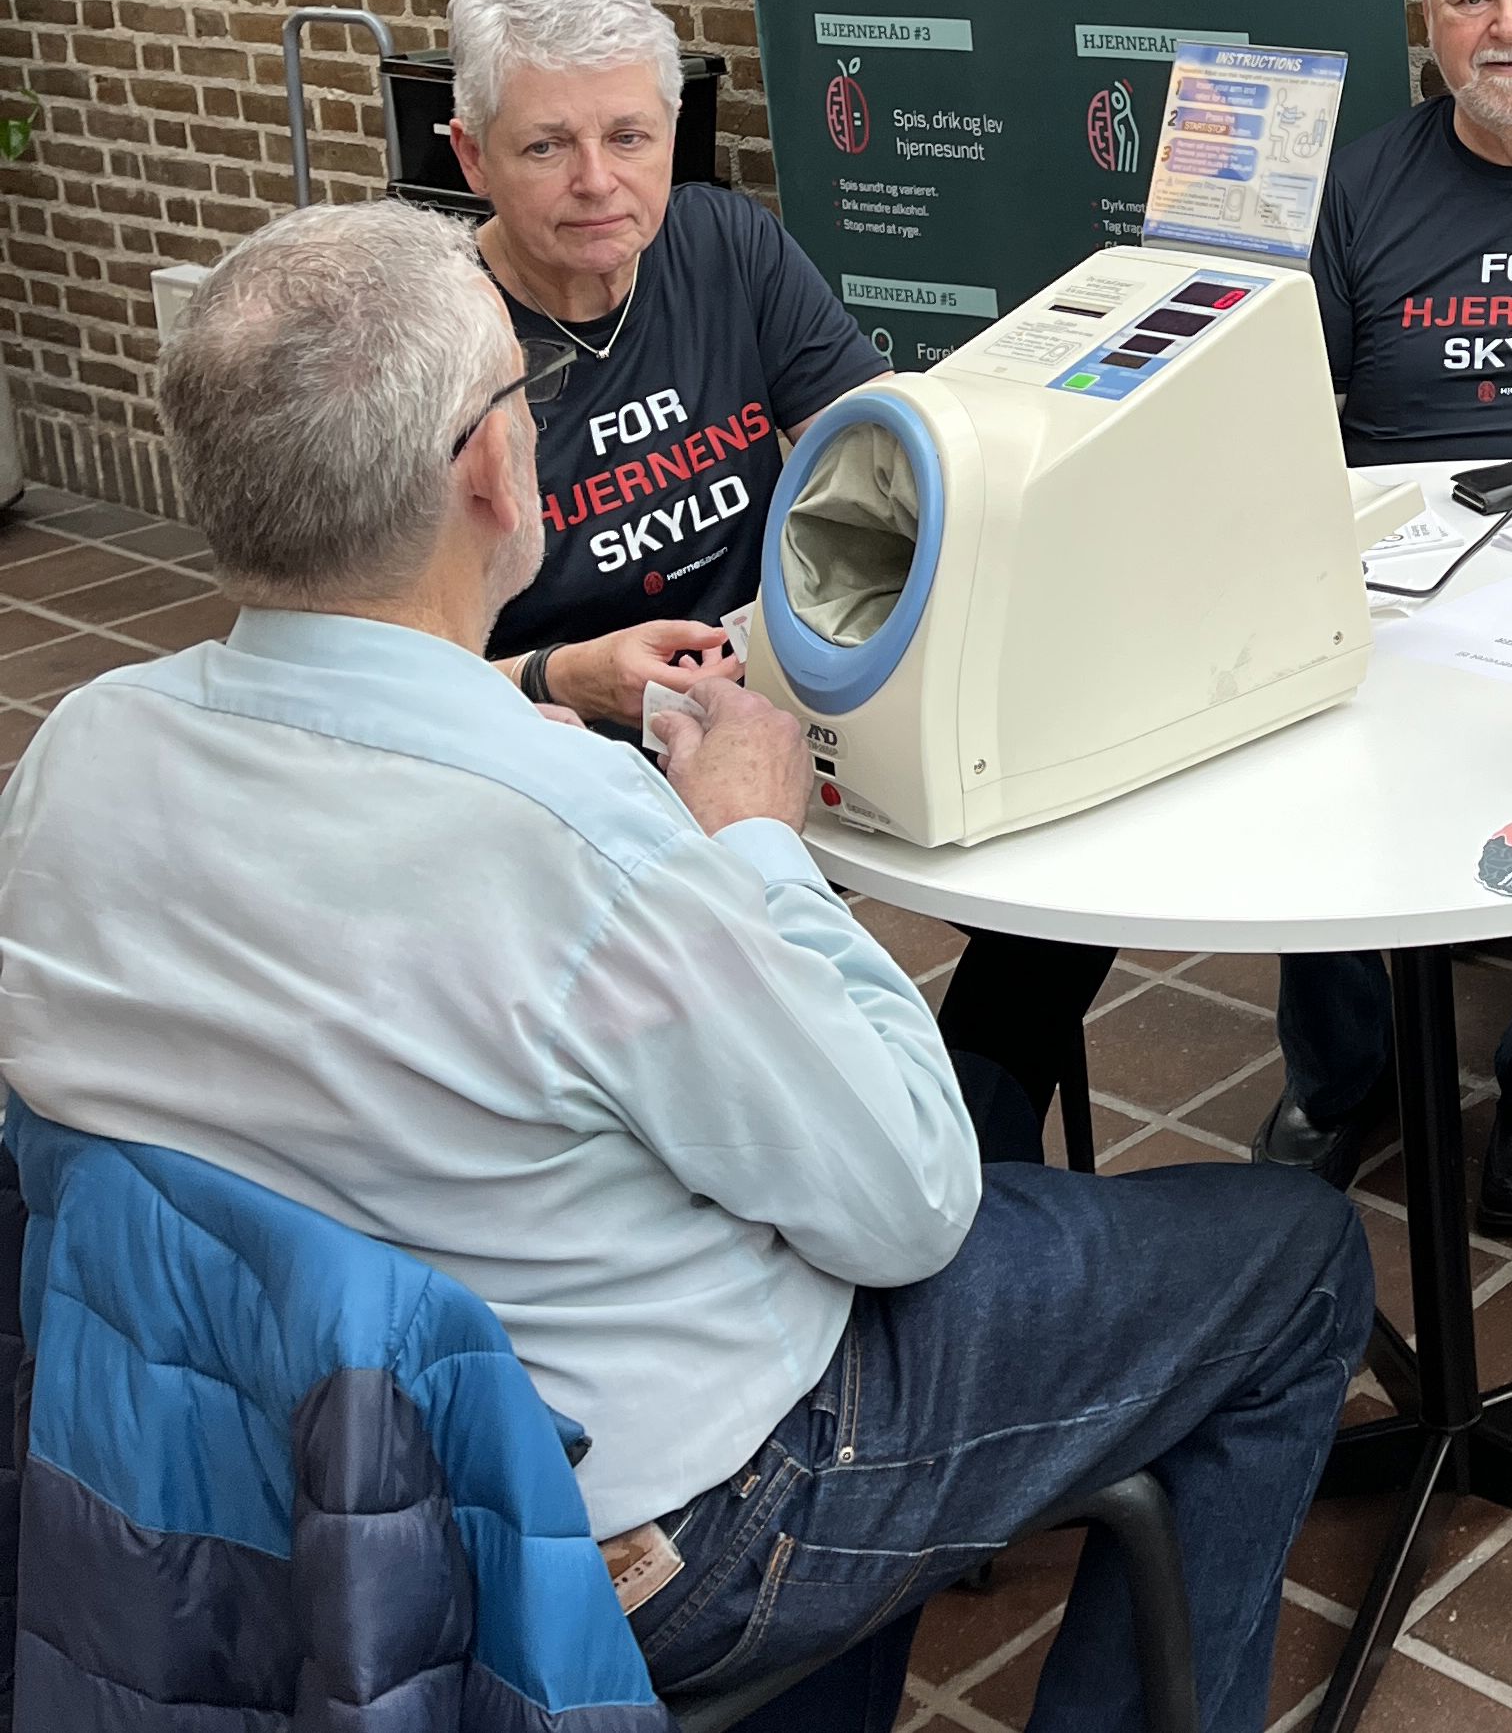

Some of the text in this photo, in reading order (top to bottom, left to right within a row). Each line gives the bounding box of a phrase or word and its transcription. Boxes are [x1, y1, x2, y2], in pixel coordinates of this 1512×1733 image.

[820, 21, 932, 42] HJERNERÅD #3
[1215, 51, 1303, 72] INSTRUCTIONS
[893, 109, 1004, 136] Spis, drik og lev
[1167, 109, 1179, 127] 2
[896, 136, 986, 161] hjernesundt
[1160, 145, 1172, 163] 3
[839, 178, 858, 193] Spis
[858, 181, 885, 194] sundt
[885, 185, 899, 197] og
[841, 198, 859, 210] Drik
[859, 201, 891, 214] mindre
[1101, 198, 1126, 213] Dyrk
[843, 218, 865, 233] Stop
[865, 221, 886, 234] med
[886, 223, 897, 235] at
[1102, 219, 1122, 235] Tag
[847, 283, 957, 307] HJERNERÅD #5
[588, 388, 688, 456] FOR
[541, 402, 771, 532] HJERNENS
[589, 475, 750, 573] SKYLD
